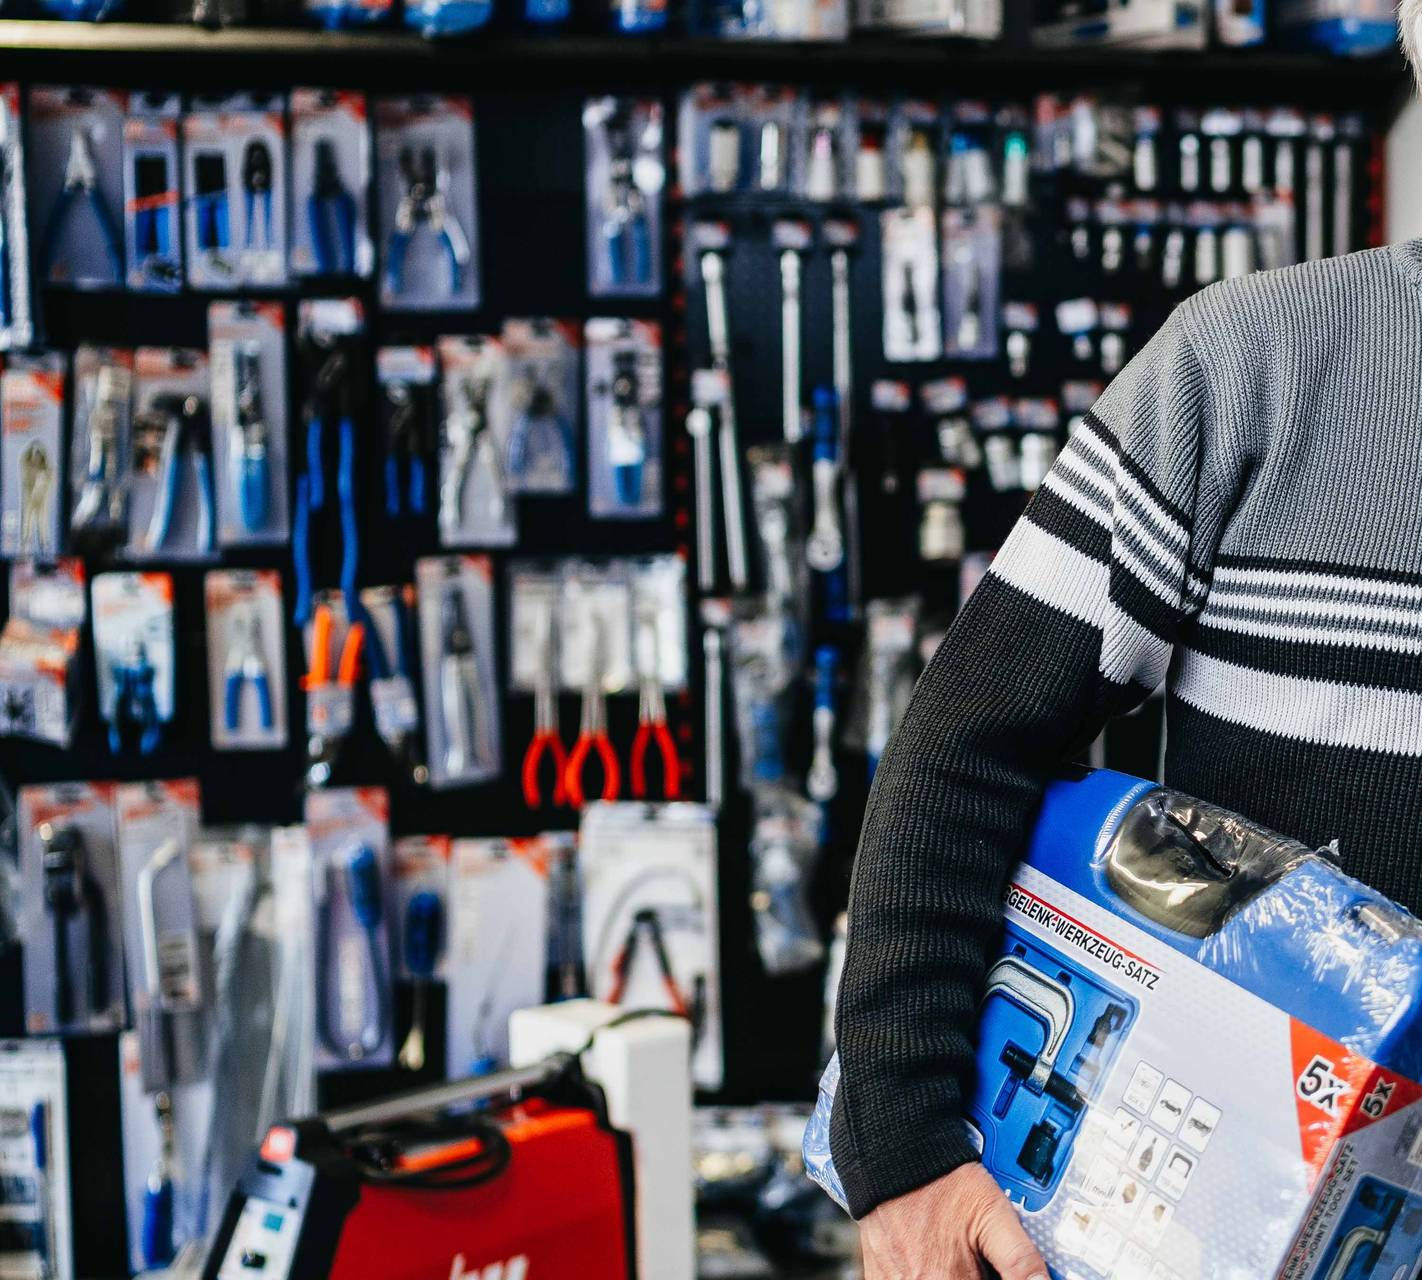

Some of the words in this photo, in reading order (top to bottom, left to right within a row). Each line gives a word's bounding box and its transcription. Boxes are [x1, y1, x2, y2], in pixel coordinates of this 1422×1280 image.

[1306, 1219, 1328, 1258] JOINT
[1324, 1187, 1345, 1217] TOOL
[1342, 1157, 1359, 1182] SET
